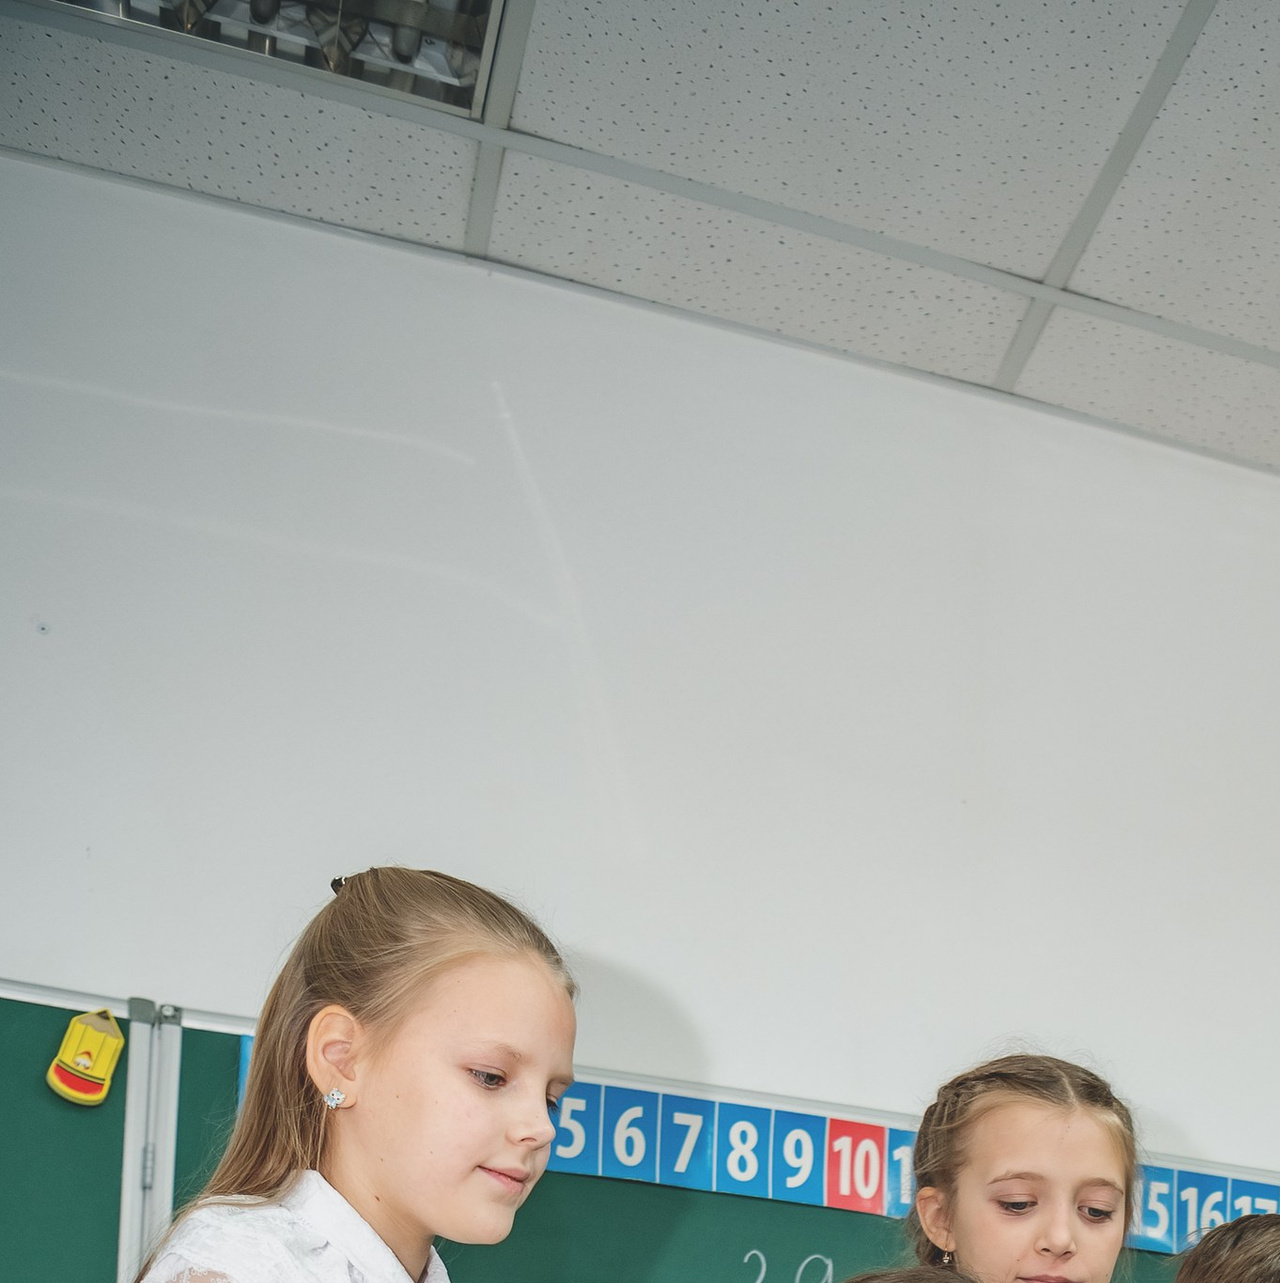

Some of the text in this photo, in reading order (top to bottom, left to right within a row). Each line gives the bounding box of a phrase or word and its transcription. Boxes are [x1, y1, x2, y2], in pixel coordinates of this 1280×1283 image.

[555, 1097, 586, 1159] 5
[613, 1106, 646, 1167] 6
[673, 1112, 704, 1173] 7
[726, 1121, 759, 1182] 8
[783, 1129, 814, 1188] 9
[832, 1136, 880, 1200] 10
[1180, 1187, 1224, 1241] 16
